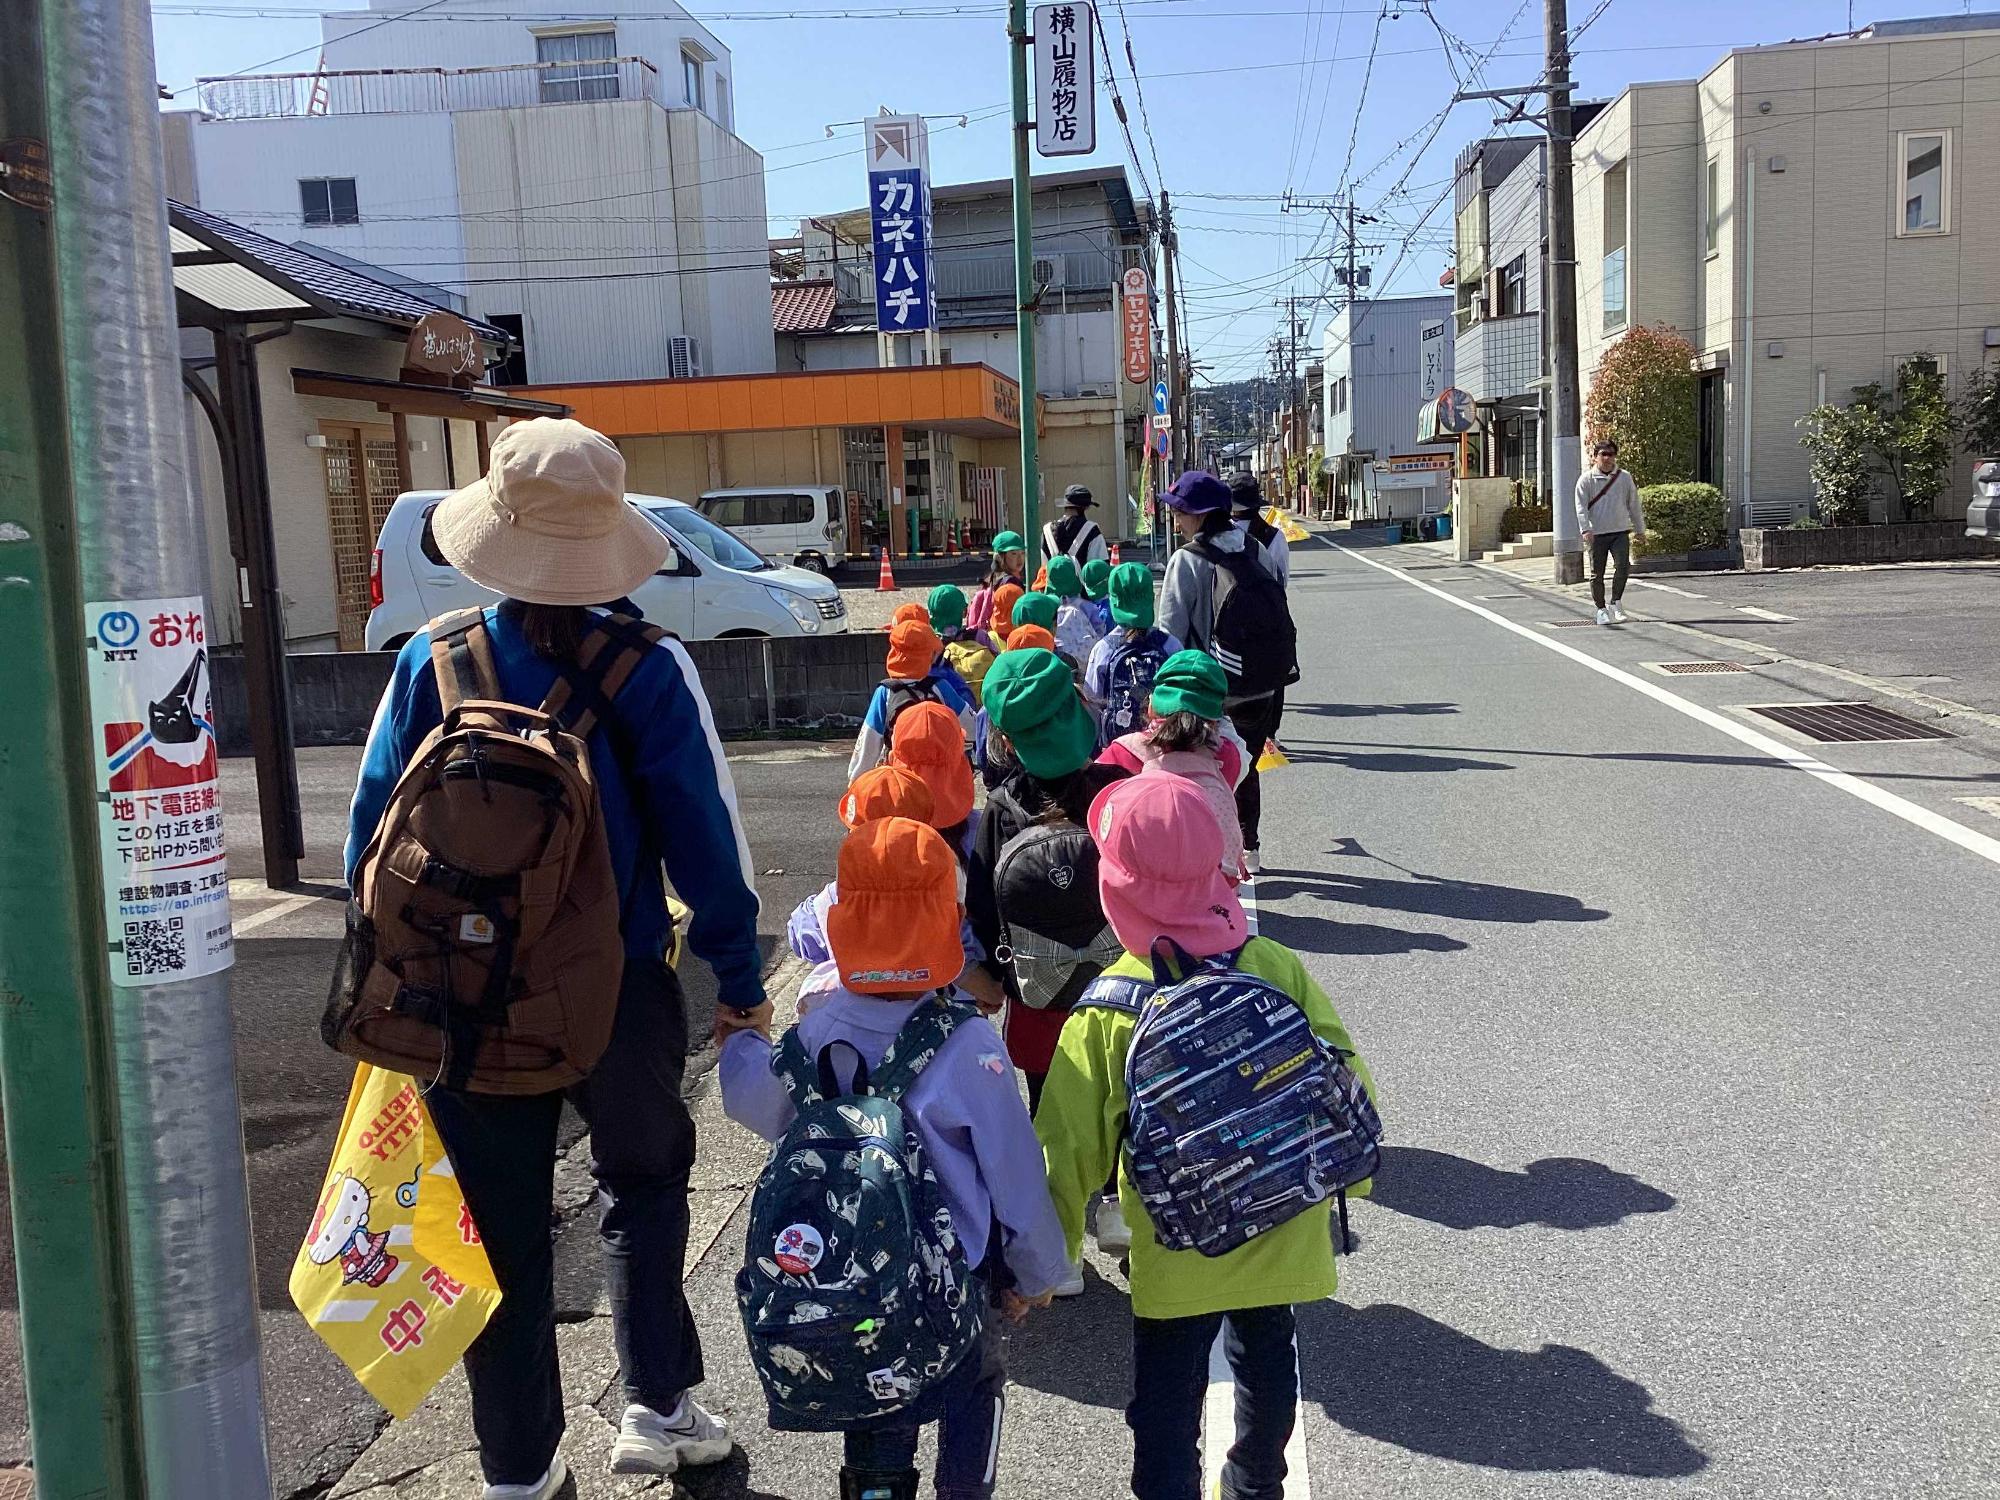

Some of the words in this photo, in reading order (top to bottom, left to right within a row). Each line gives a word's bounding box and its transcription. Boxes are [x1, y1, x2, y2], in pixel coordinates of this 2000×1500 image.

[1049, 7, 1077, 141] 横山履物店
[878, 177, 921, 325] カネハチ
[1127, 296, 1146, 378] ヤマザキパン
[103, 649, 138, 662] NTT
